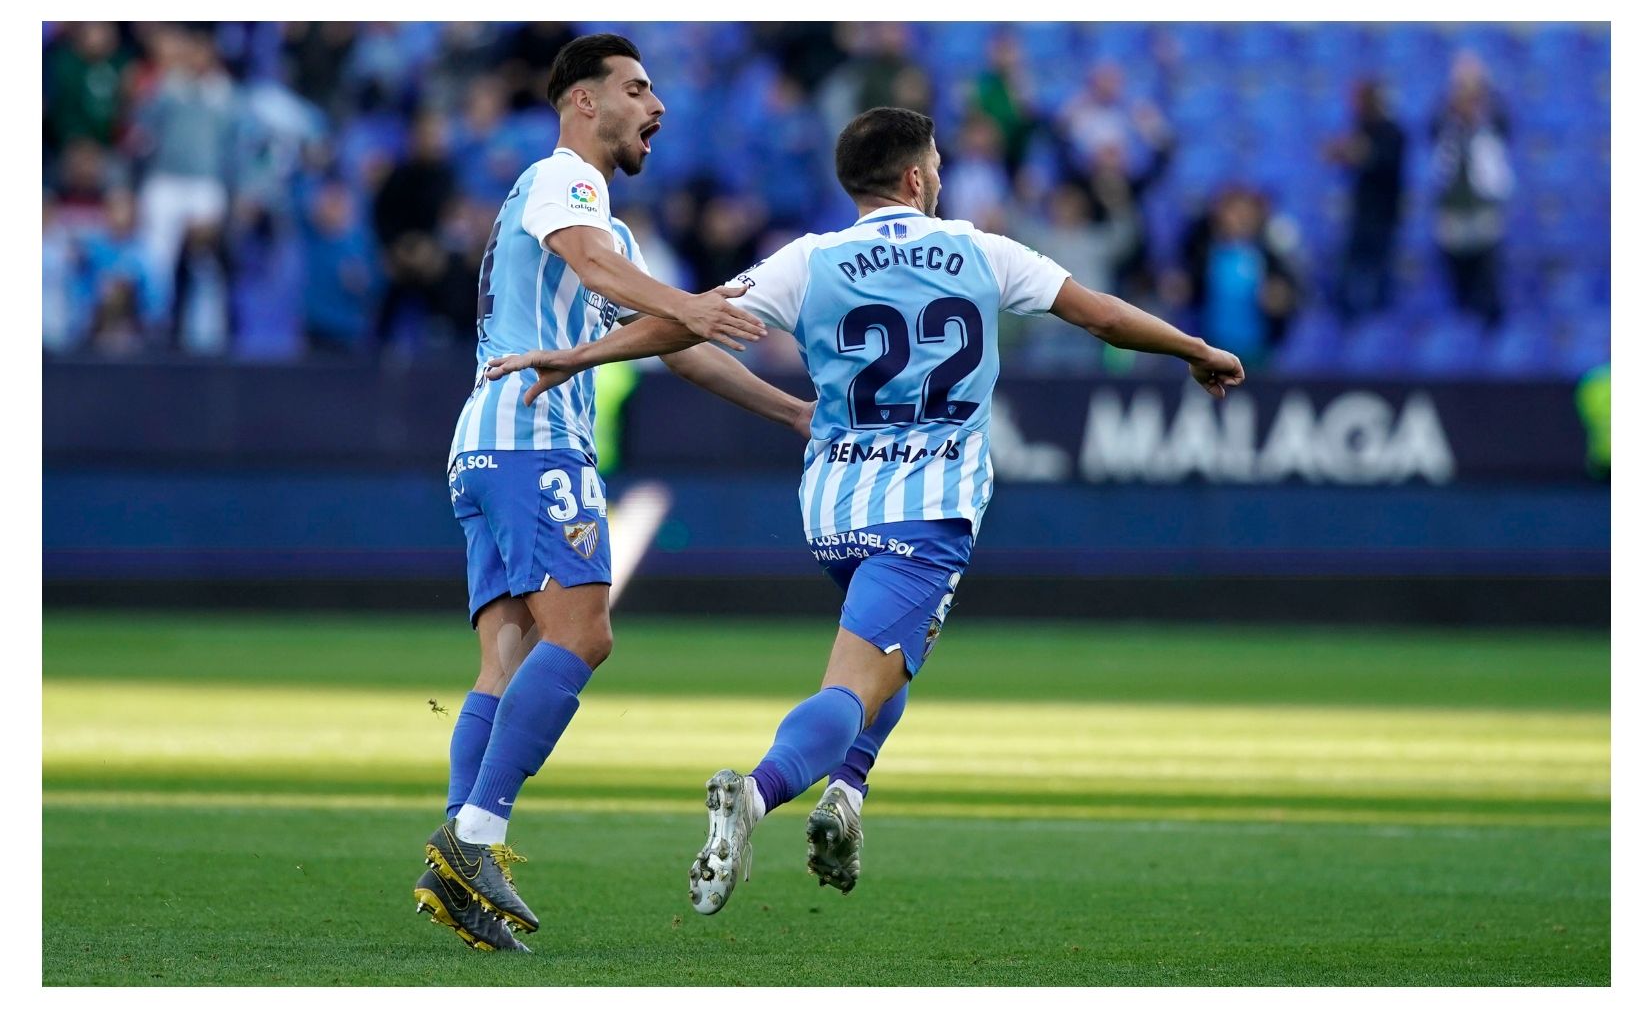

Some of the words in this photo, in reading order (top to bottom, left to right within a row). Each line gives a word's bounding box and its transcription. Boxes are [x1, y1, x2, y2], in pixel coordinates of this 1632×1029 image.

[570, 203, 598, 213] LaLiga
[838, 245, 964, 283] PACHECO
[836, 297, 985, 429] 22
[467, 454, 498, 470] SOL
[539, 466, 608, 522] 34
[859, 531, 885, 549] DEL
[887, 538, 916, 558] SOL
